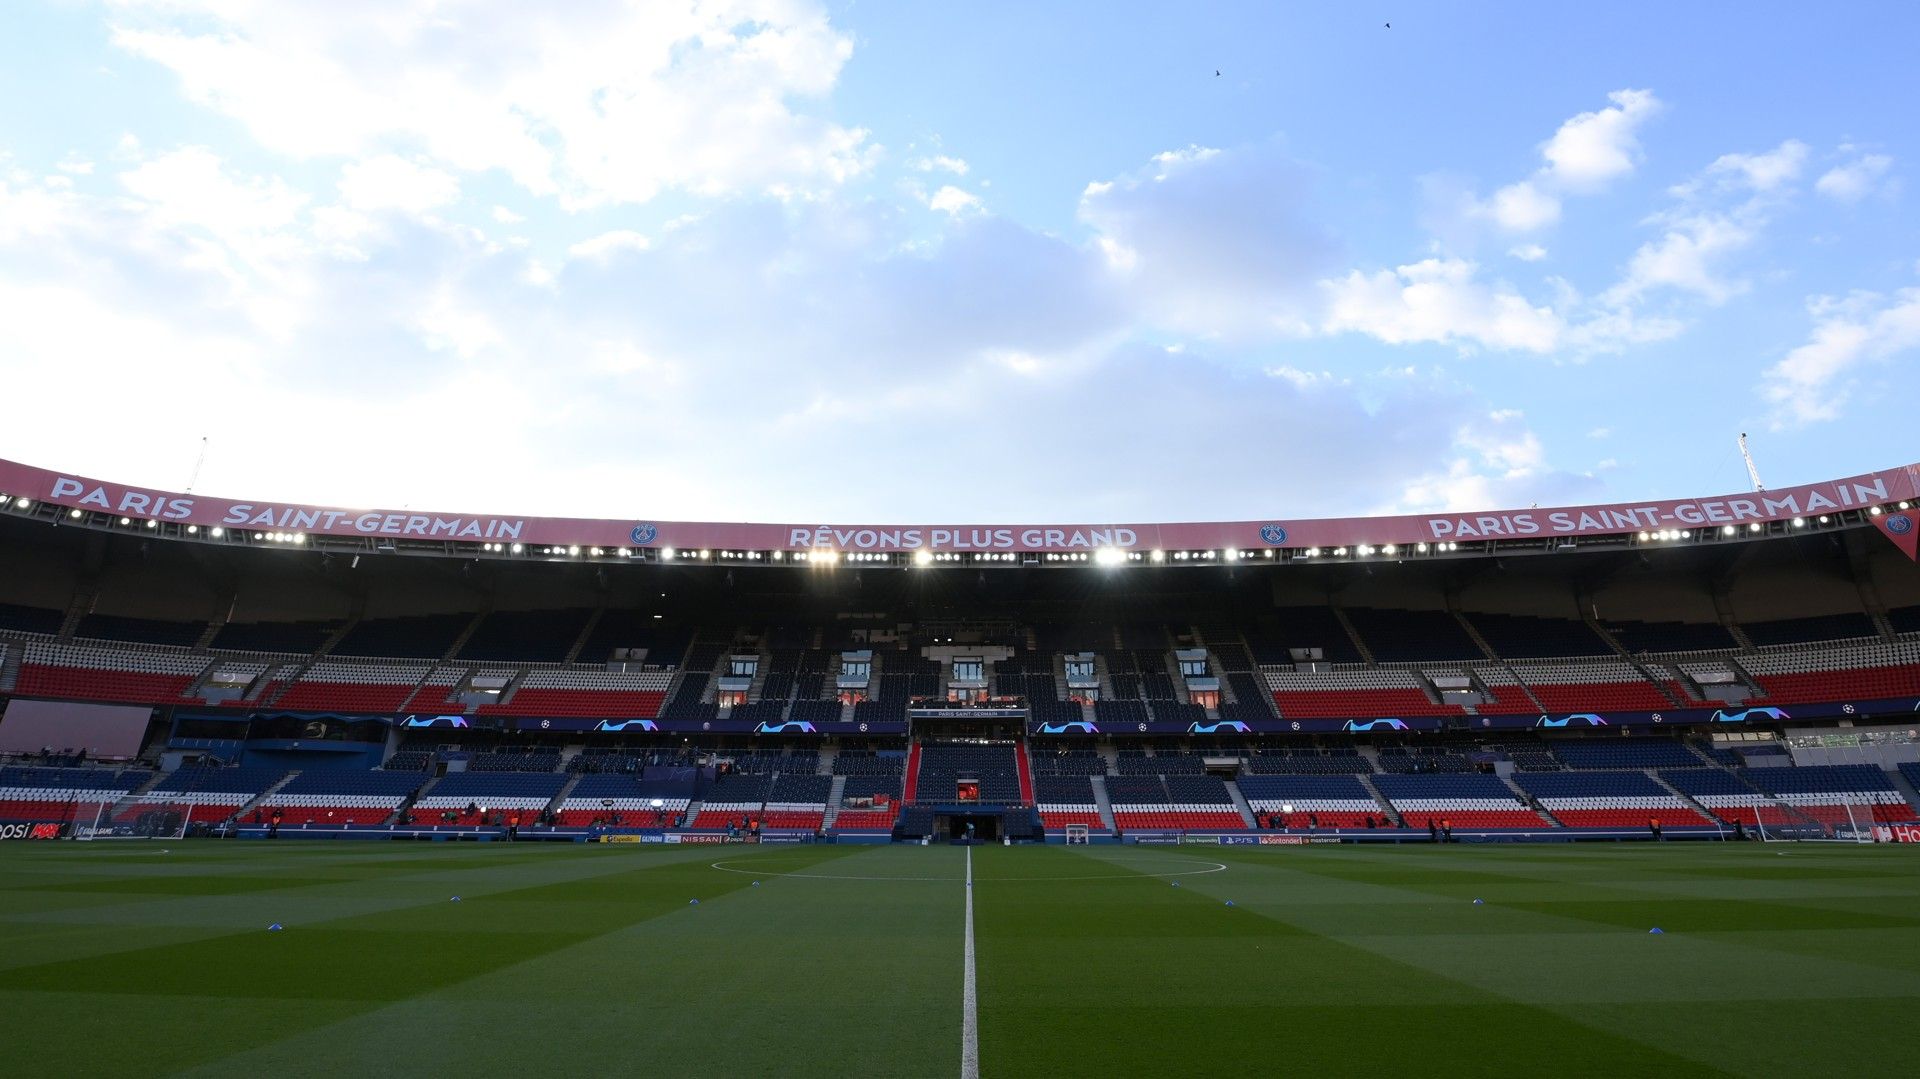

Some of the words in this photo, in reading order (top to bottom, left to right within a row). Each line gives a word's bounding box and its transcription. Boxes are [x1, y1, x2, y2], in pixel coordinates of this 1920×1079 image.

[50, 477, 194, 519] PARIS
[222, 504, 524, 538] SAINT-GERMAIN
[1428, 514, 1540, 538] PARIS
[1548, 478, 1888, 531] SAINT-GERMAIN
[789, 525, 923, 548] RÊVONS
[931, 530, 1014, 548] PLUS
[1021, 529, 1137, 548] GRAND
[0, 822, 31, 840] psi
[1268, 836, 1300, 844] Santander
